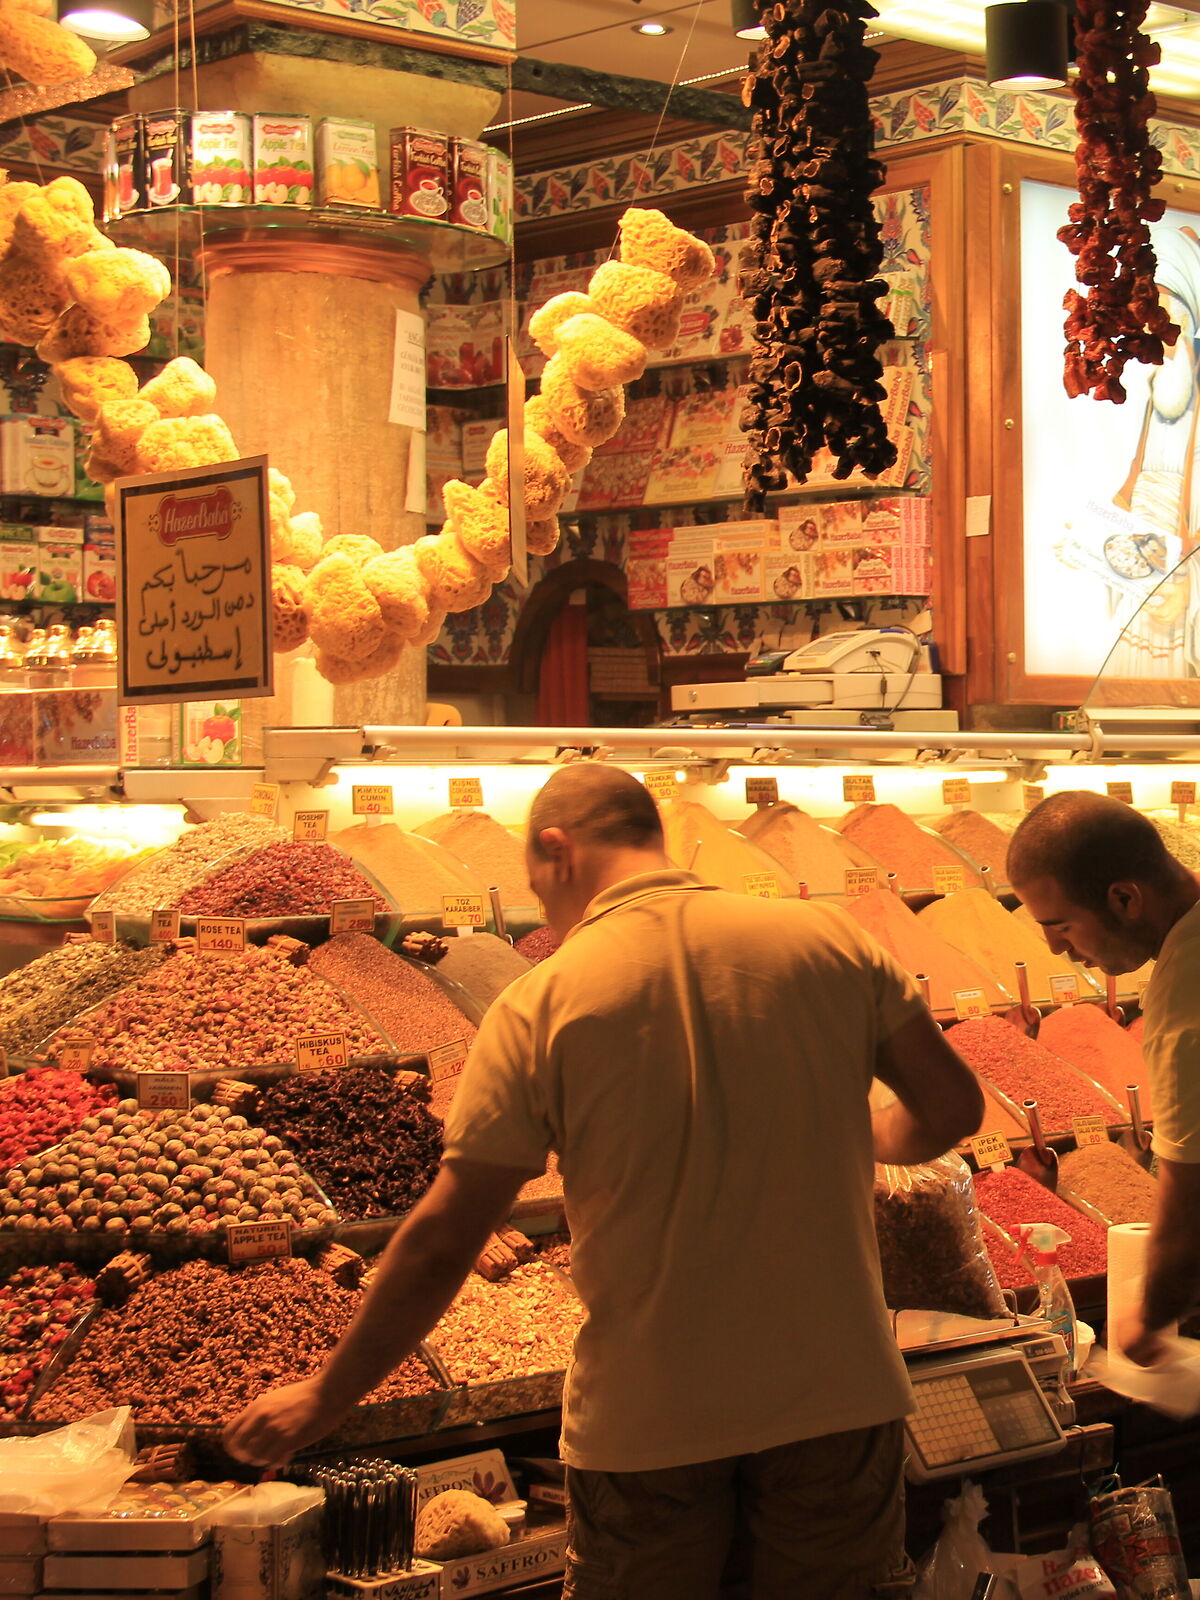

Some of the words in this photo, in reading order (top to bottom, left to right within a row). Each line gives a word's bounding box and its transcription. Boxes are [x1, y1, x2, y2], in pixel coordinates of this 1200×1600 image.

[261, 139, 288, 152] Apple
[896, 371, 913, 425] HazerBaba
[894, 430, 914, 484] HazerBaba
[164, 502, 229, 534] HazerBaba
[181, 597, 221, 631] الورد
[124, 706, 137, 763] HazerBa
[462, 794, 473, 804] 40
[366, 802, 380, 814] 40
[303, 821, 317, 829] TEA
[305, 829, 317, 839] 40
[857, 885, 869, 894] 60
[158, 919, 172, 927] TEA
[467, 914, 481, 923] 70
[201, 925, 222, 934] ROSE
[225, 926, 241, 935] TEA
[211, 938, 233, 949] 140
[1063, 991, 1074, 1000] 70
[968, 1006, 980, 1014] 80
[310, 1048, 330, 1057] TEA
[150, 1095, 178, 1106] 250
[233, 1233, 264, 1245] APPLE
[266, 1231, 286, 1241] TEA
[418, 1478, 474, 1501] AFFRON
[475, 1545, 562, 1581] SAFFRON
